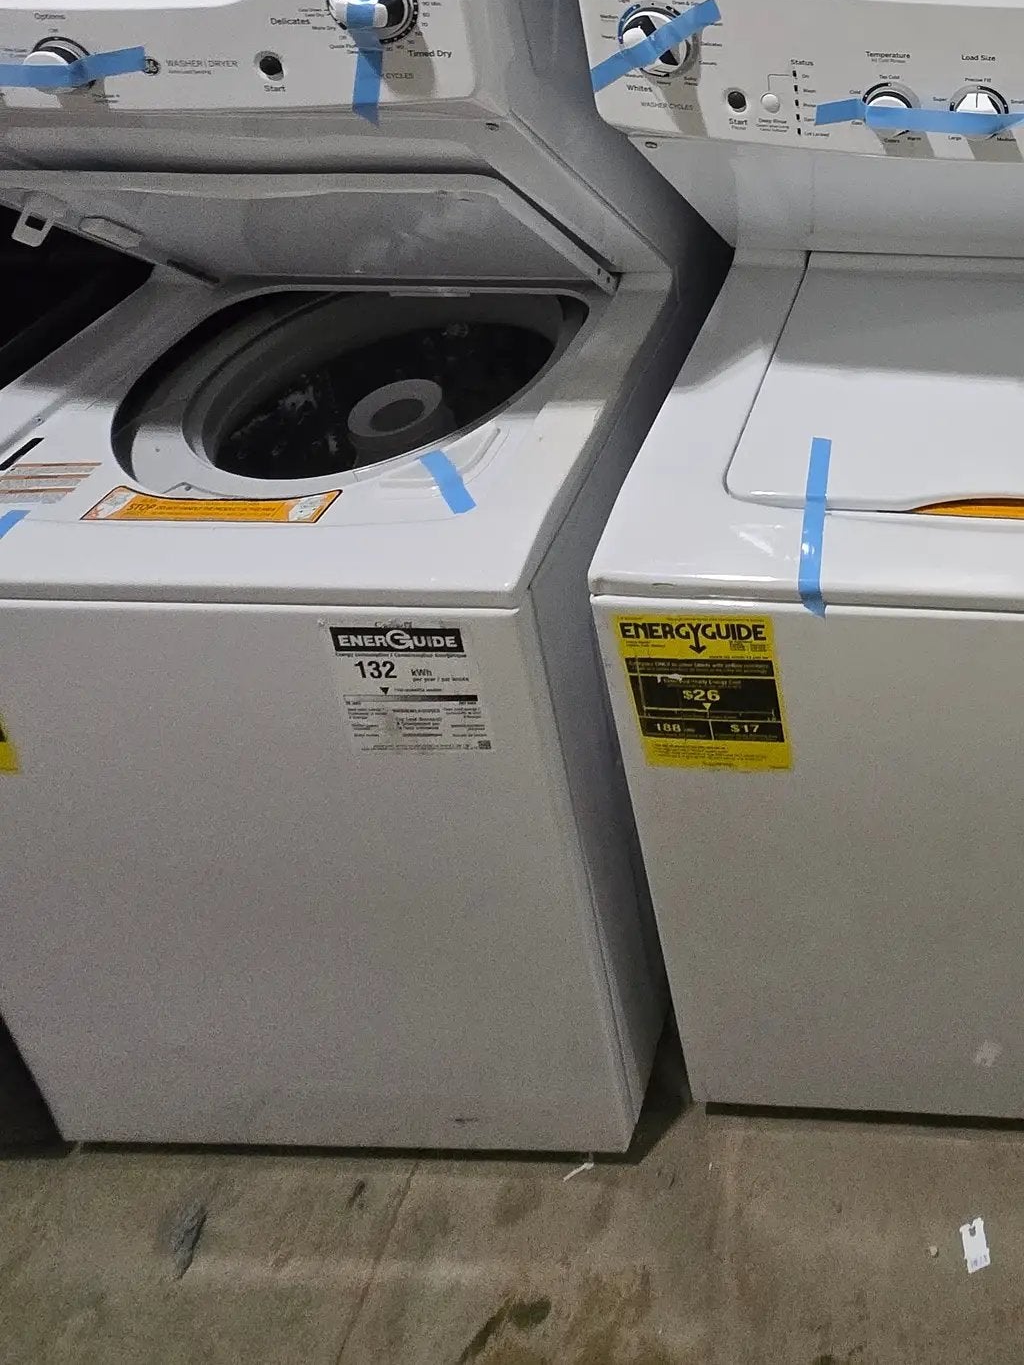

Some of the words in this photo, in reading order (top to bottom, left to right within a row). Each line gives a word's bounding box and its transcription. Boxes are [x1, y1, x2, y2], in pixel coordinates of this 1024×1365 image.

[34, 13, 66, 21] Options
[407, 50, 435, 58] Timed
[436, 50, 452, 59] Dry
[865, 51, 911, 60] Temperature
[165, 59, 201, 68] WASHER
[208, 59, 239, 68] DRYER
[791, 59, 814, 67] Status
[264, 85, 286, 93] Start
[626, 84, 653, 93] Whites
[641, 101, 668, 109] WASHER
[669, 103, 694, 111] CYCLES
[127, 504, 156, 512] STOP
[618, 622, 767, 642] ENERGYGUIDE
[337, 629, 458, 650] ENERGUIDE
[354, 660, 398, 679] 132
[411, 668, 432, 677] kWh
[682, 689, 721, 702] $26
[730, 724, 760, 734] $17
